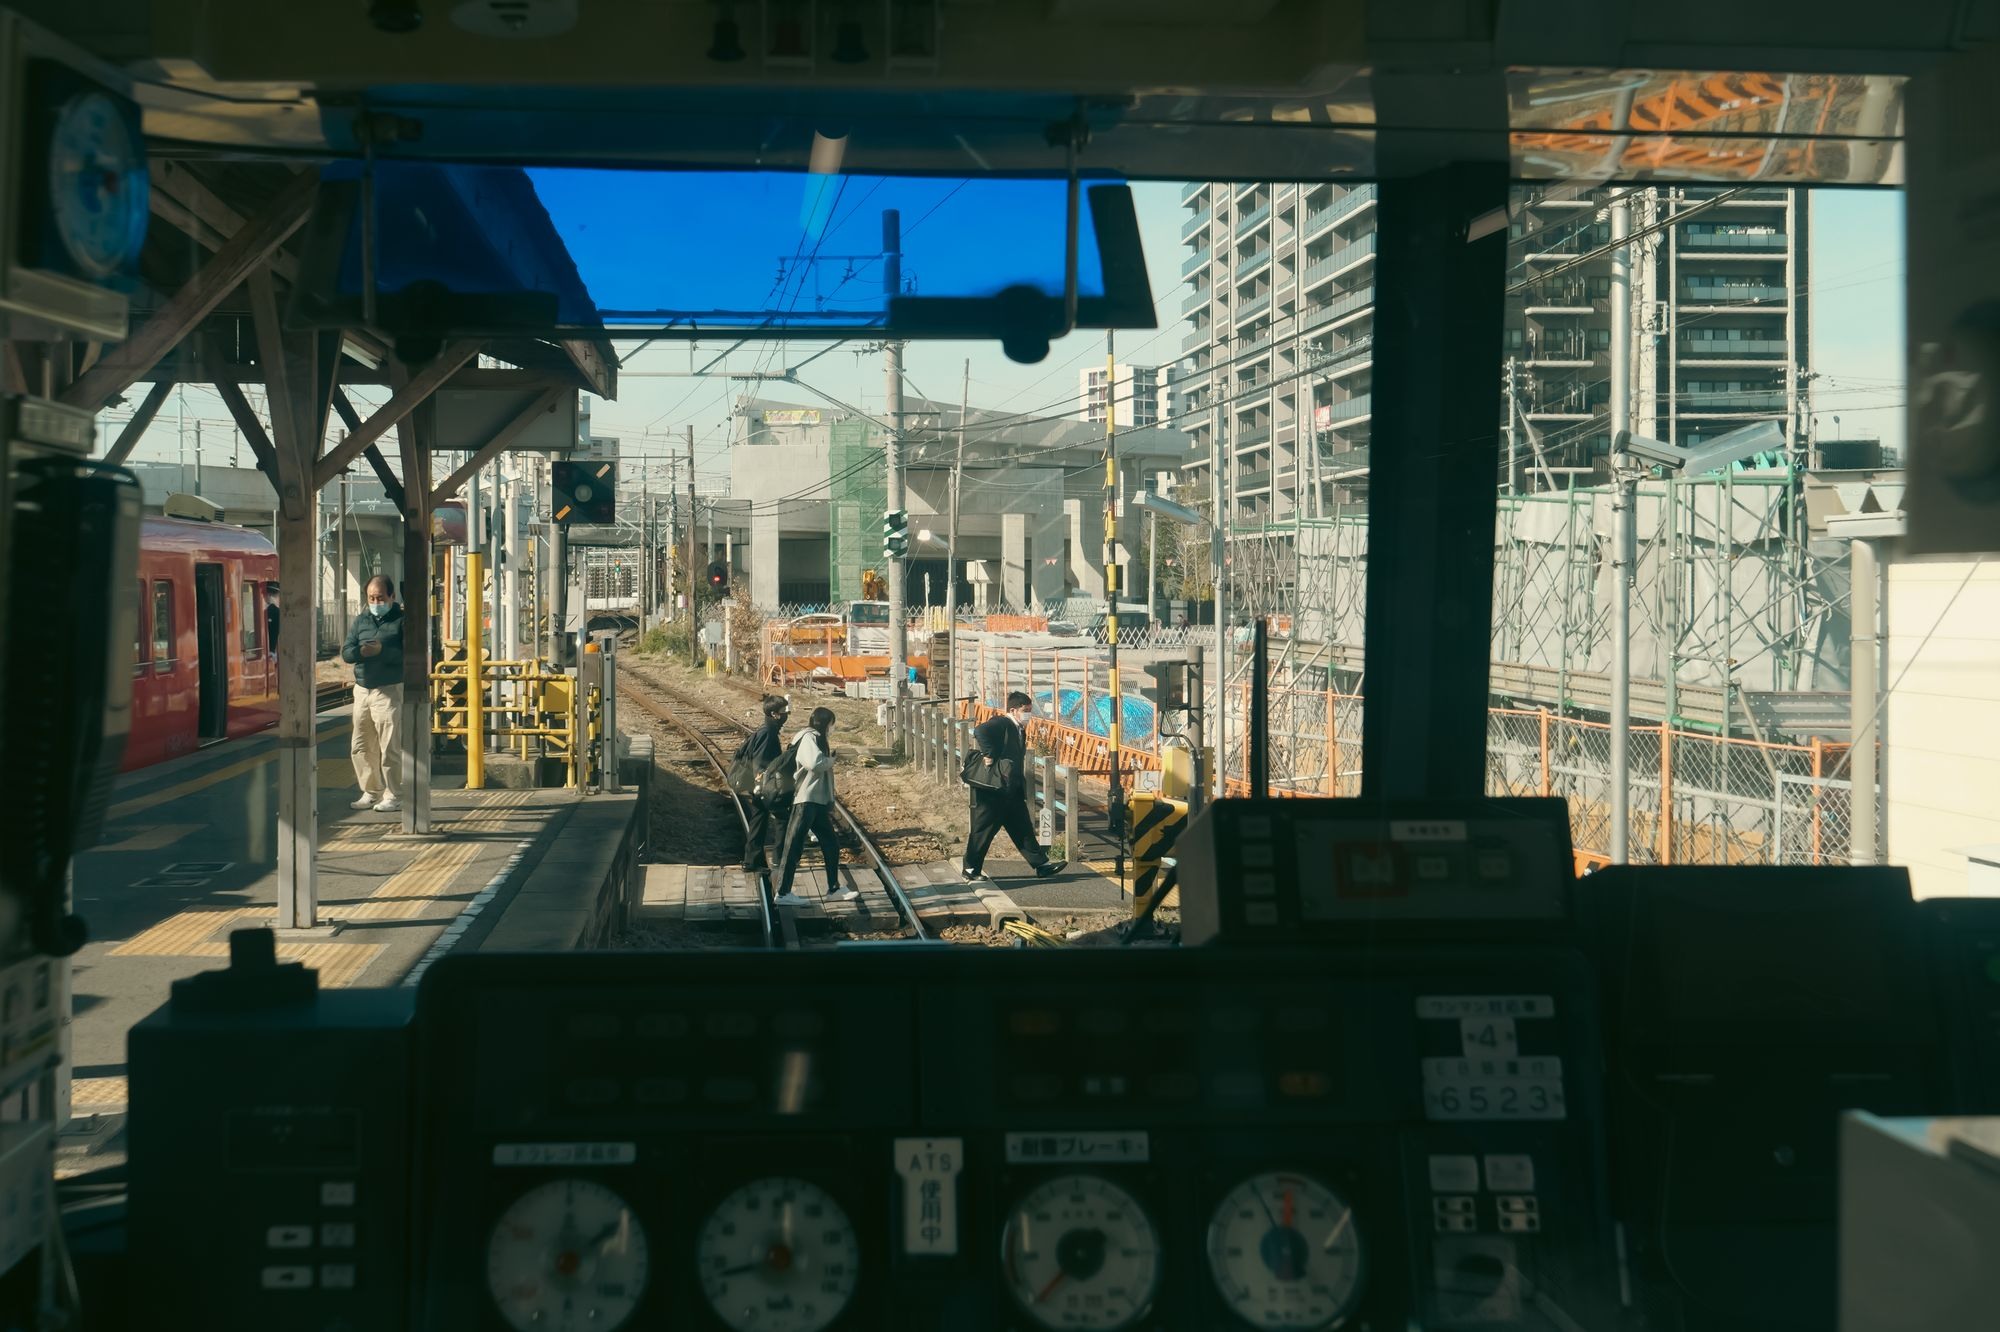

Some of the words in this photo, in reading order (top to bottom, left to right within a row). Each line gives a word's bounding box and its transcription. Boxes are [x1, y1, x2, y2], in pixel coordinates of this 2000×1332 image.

[1041, 814, 1051, 838] 240
[1479, 1023, 1497, 1048] 4
[1441, 1086, 1549, 1114] 6523
[909, 1153, 952, 1172] ATS
[920, 1179, 942, 1246] 使用中
